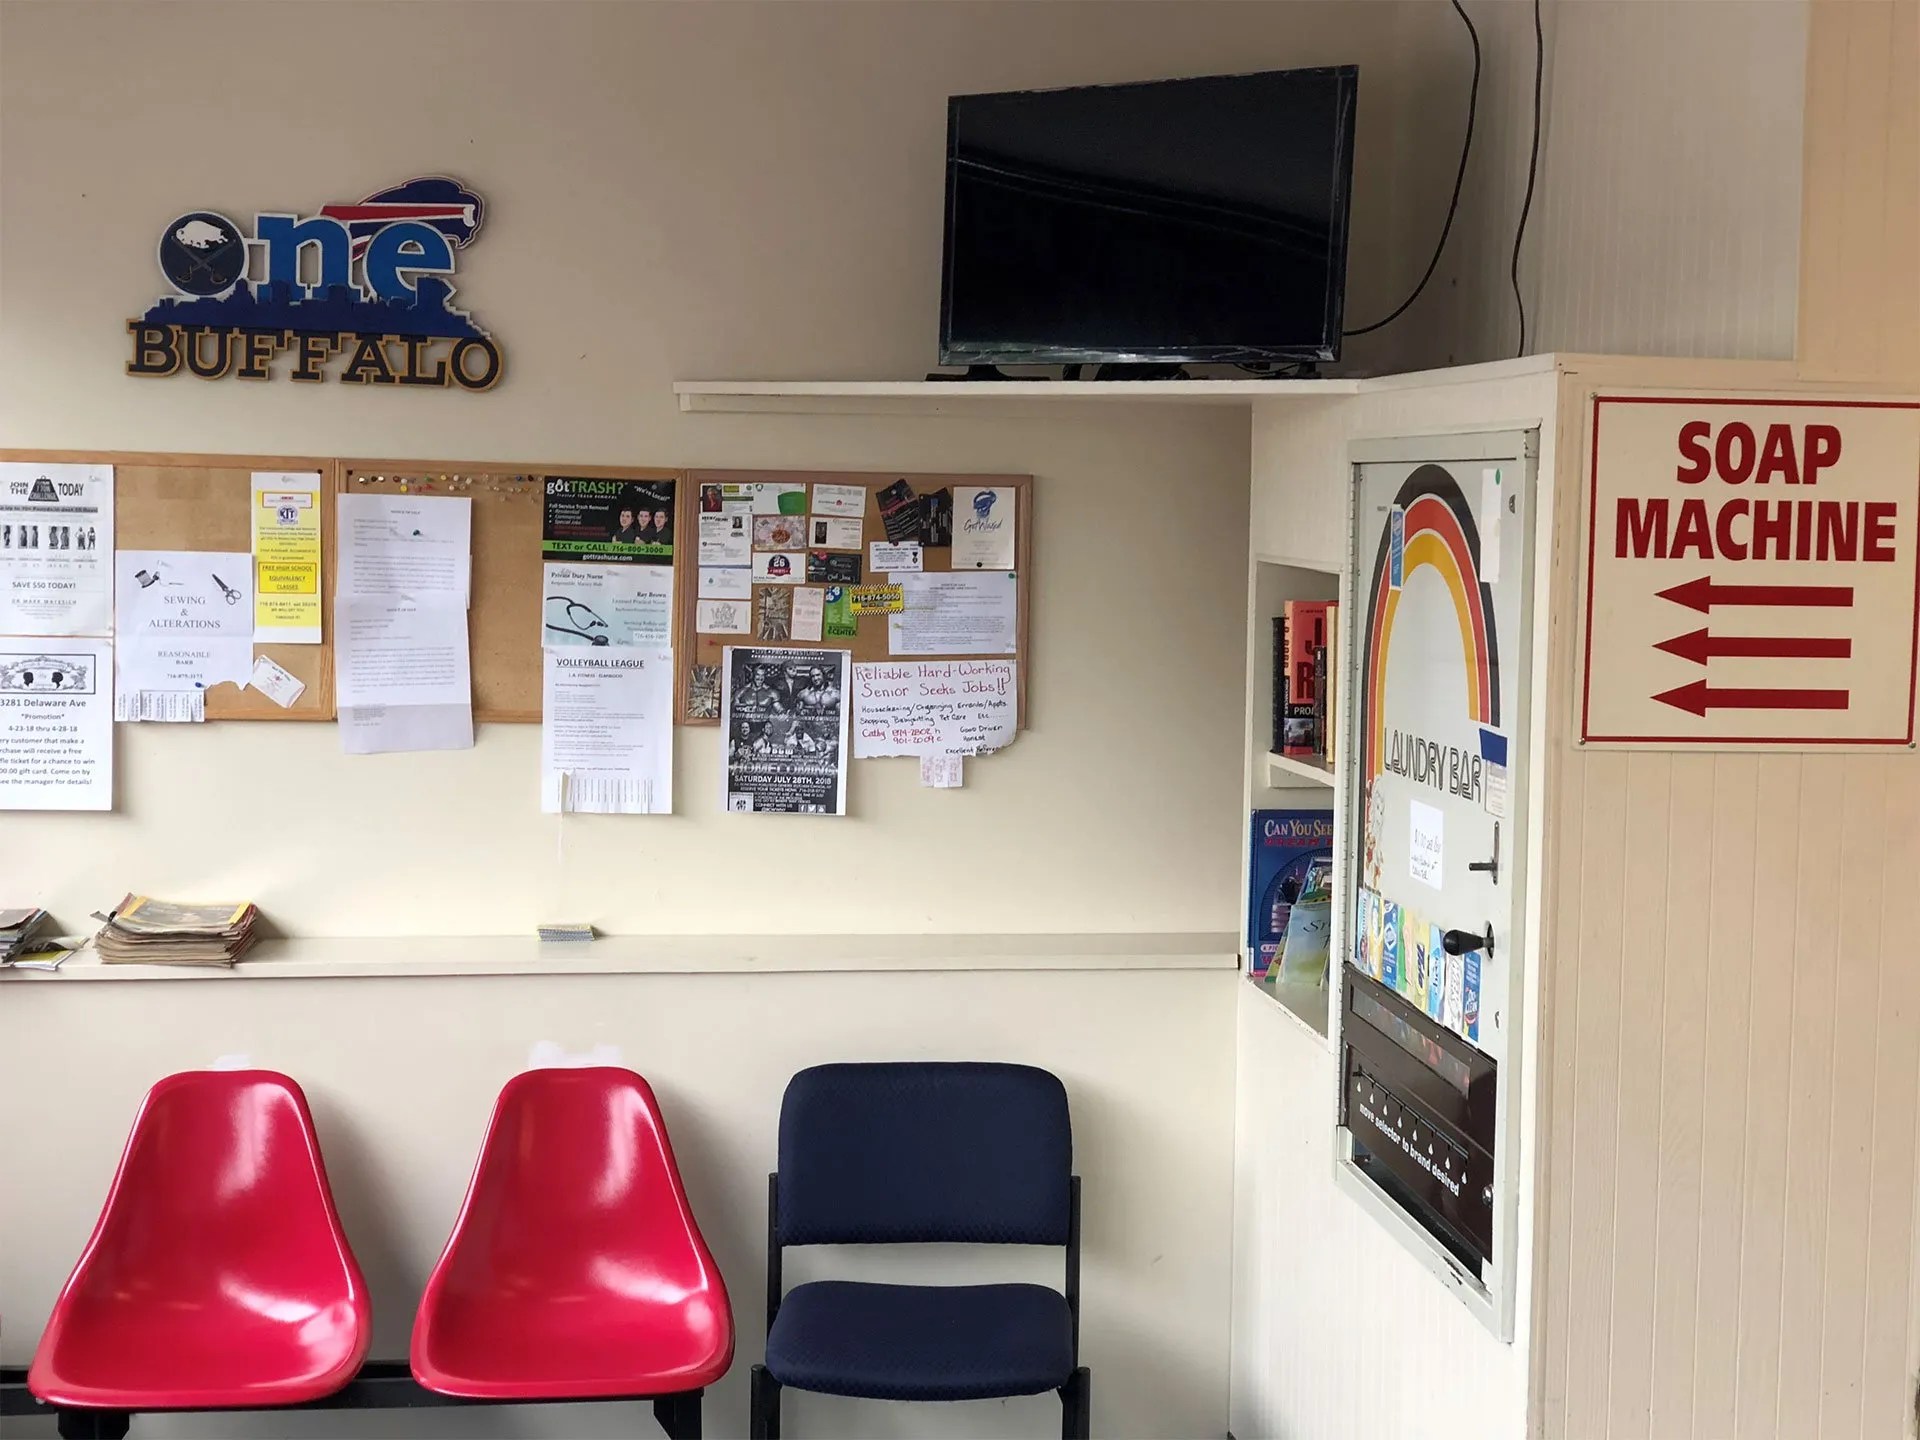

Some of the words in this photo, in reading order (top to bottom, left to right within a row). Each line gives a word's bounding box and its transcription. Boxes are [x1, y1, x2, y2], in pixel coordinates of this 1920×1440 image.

[126, 318, 503, 392] BUFFALO
[1677, 421, 1842, 485] SOAP
[58, 483, 84, 496] TODAY
[1615, 498, 1897, 562] MACHINE
[552, 542, 572, 550] TEXT
[164, 596, 206, 605] SEWING
[180, 608, 188, 616] &
[149, 620, 221, 629] ALTERATIONS
[158, 650, 210, 658] REASONABLE
[556, 658, 609, 668] VOLLEYBALL
[610, 660, 644, 668] LEAGUE
[856, 666, 912, 682] Reliable
[918, 663, 1011, 682] Hard-Working
[862, 683, 910, 698] Senior
[920, 683, 956, 696] Seeks
[24, 699, 66, 708] Delaware
[69, 700, 86, 708] Ave
[862, 728, 886, 741] Cathy
[19, 768, 30, 776] gift
[1384, 728, 1447, 790] LAUNDRY
[1450, 748, 1481, 803] BAR
[1360, 1103, 1375, 1122] move
[1375, 1117, 1400, 1144] selector
[1402, 1138, 1410, 1153] to
[1410, 1144, 1430, 1172] brand
[1432, 1163, 1460, 1197] desired
